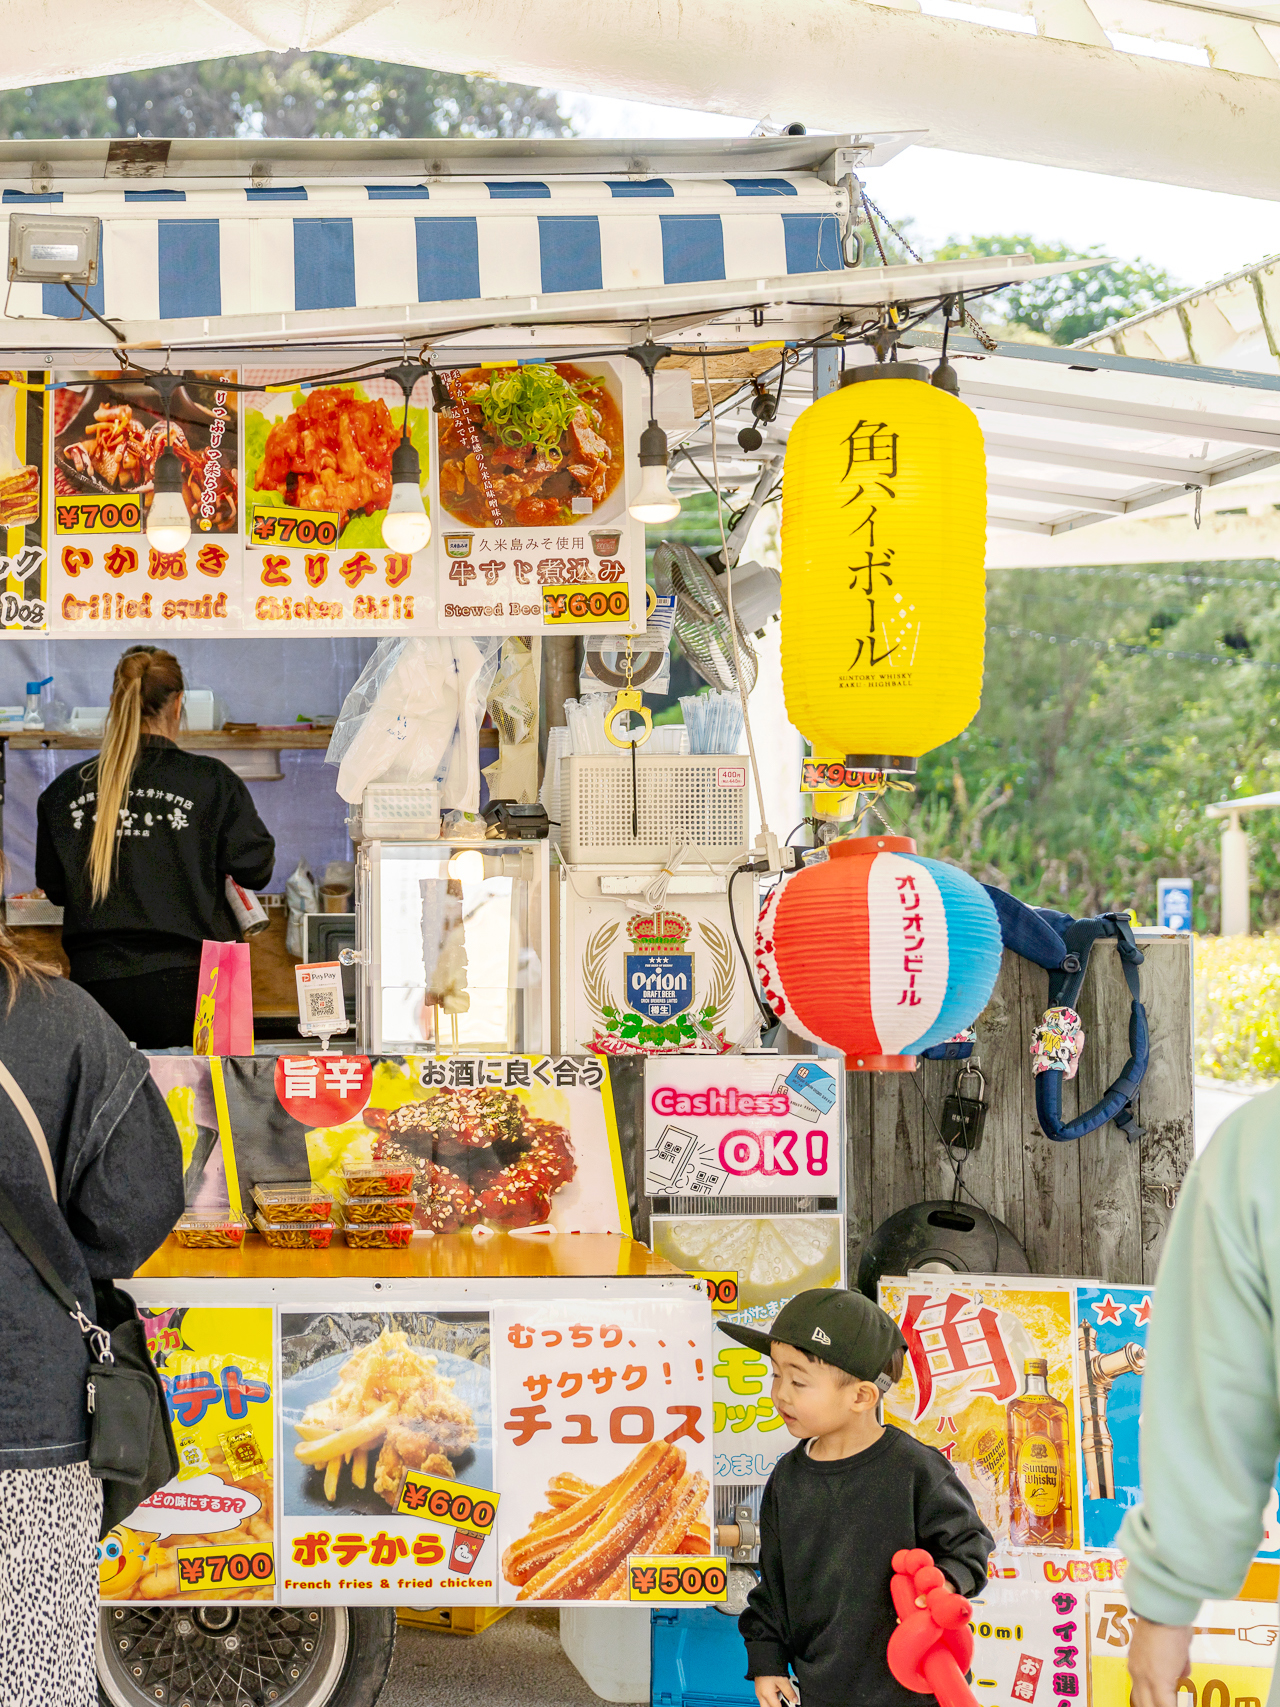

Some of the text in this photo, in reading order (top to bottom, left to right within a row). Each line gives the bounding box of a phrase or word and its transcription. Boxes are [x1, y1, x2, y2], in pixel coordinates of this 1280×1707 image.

[57, 503, 140, 529] ¥700
[254, 516, 337, 545] ¥700
[479, 537, 584, 552] 久米島みそ使用
[840, 420, 900, 671] 角ハイボール
[61, 544, 229, 581] いか焼き
[261, 552, 413, 589] とりチリ
[449, 558, 625, 586] 牛すじ煮込み
[62, 592, 228, 620] Grilled squid
[445, 602, 541, 617] Stewed Bee
[544, 592, 629, 617] ¥600
[895, 875, 925, 1006] オリオンビール
[631, 967, 688, 990] Orion
[662, 990, 676, 998] BEER
[283, 1059, 363, 1099] 旨辛
[421, 1058, 605, 1088] お酒に良く合う
[652, 1087, 790, 1116] Cashless
[899, 1293, 1017, 1421] 角
[161, 1366, 271, 1427] テト
[503, 1403, 706, 1446] チュロス
[1022, 1463, 1058, 1475] Suntory
[1024, 1474, 1057, 1487] Whisky
[402, 1482, 495, 1527] ¥600
[291, 1533, 446, 1567] ポテから
[179, 1550, 274, 1583] ¥700
[631, 1565, 726, 1594] ¥500
[284, 1577, 493, 1590] French fries & fried chicken
[1014, 1656, 1042, 1702] お得
